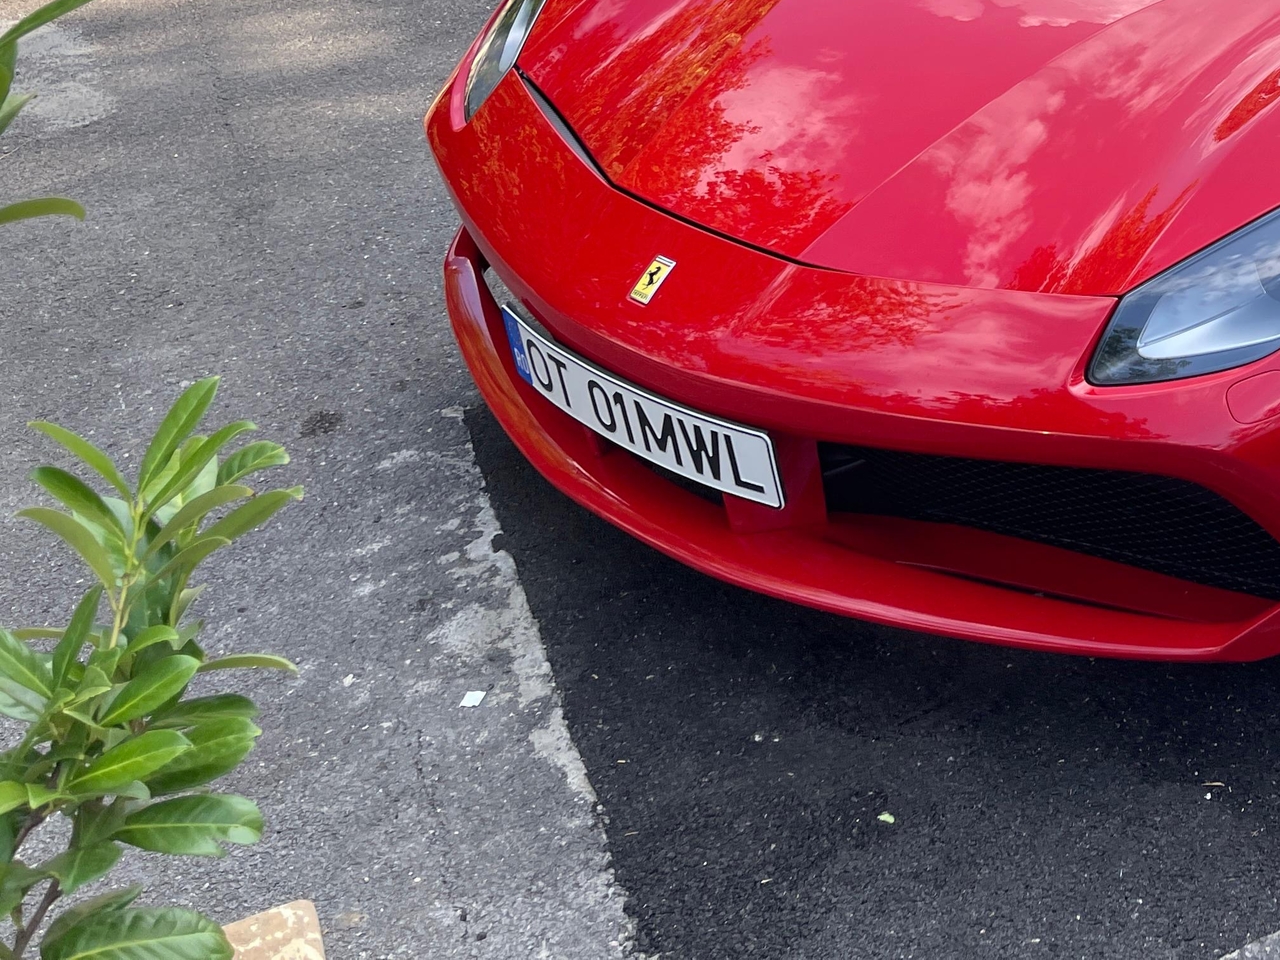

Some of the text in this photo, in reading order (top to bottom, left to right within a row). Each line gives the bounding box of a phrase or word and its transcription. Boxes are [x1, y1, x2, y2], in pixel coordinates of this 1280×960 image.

[513, 338, 765, 495] RO OT 01MWL
